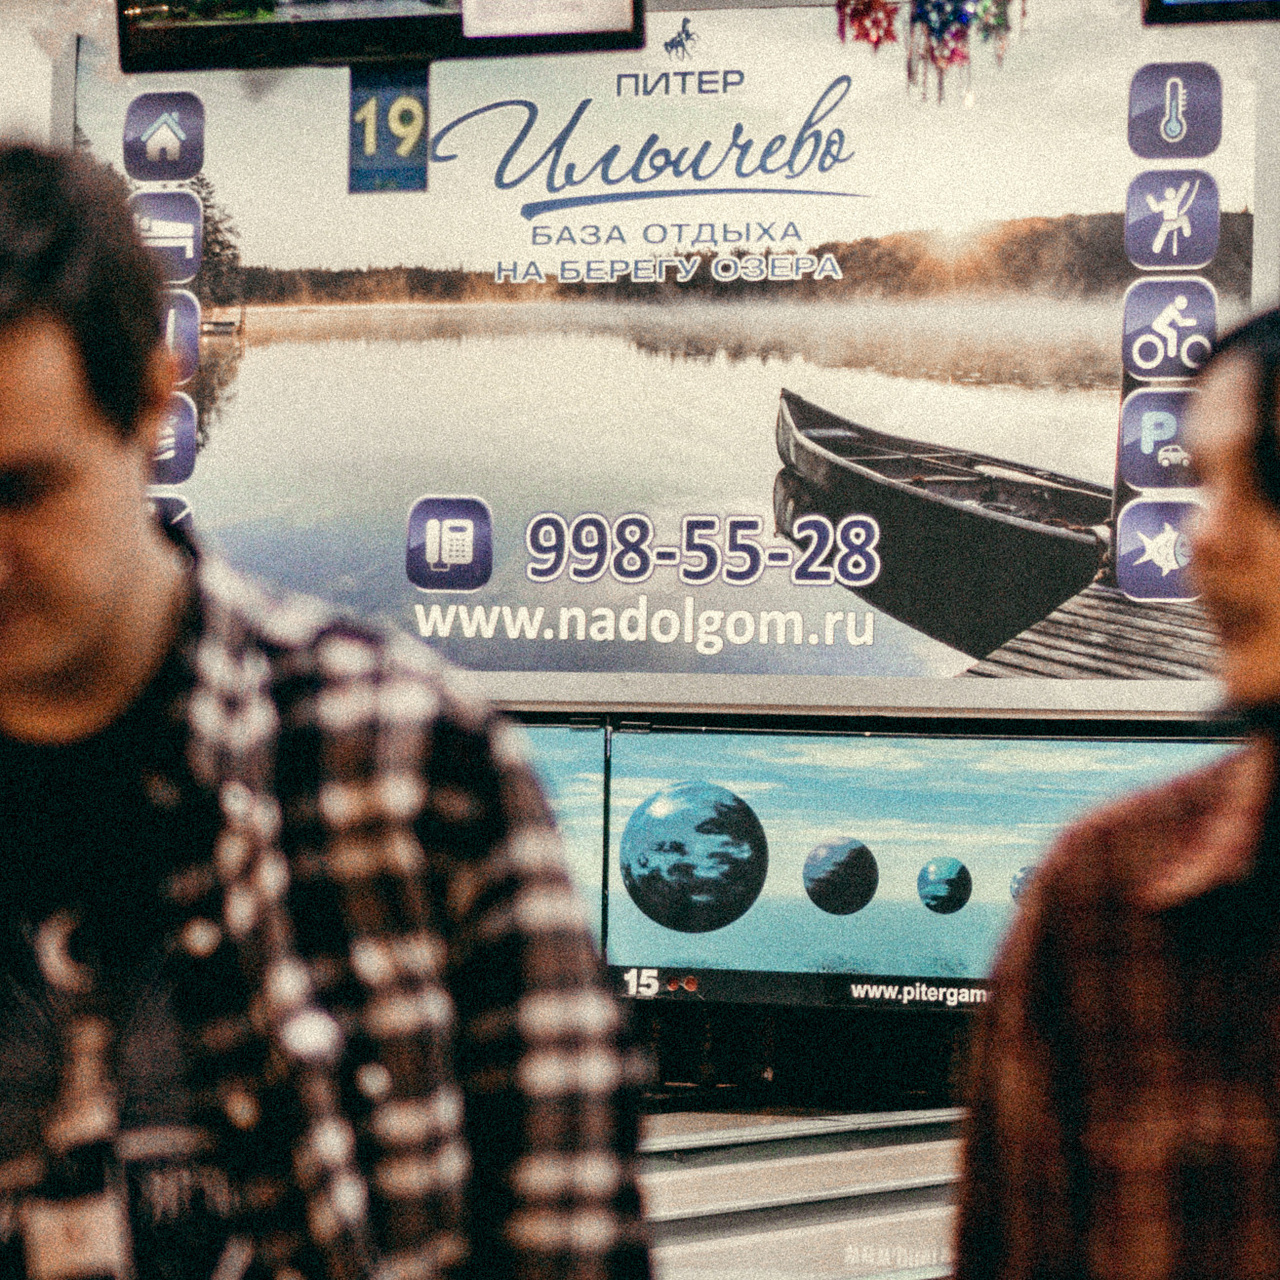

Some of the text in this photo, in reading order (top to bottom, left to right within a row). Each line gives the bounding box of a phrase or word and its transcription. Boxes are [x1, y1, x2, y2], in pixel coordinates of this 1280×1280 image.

[616, 70, 746, 97] ПИТЕР
[354, 95, 425, 158] 19
[430, 75, 856, 194] Ильичево
[531, 221, 803, 247] БАЗА ОТДЫХА
[495, 254, 843, 284] НА БЕРЕГУ ОЗЕРА
[526, 512, 882, 586] 998-55-28
[414, 594, 875, 656] www.nadolgom.ru
[623, 968, 660, 997] 15
[850, 981, 988, 1007] www.pitergam
